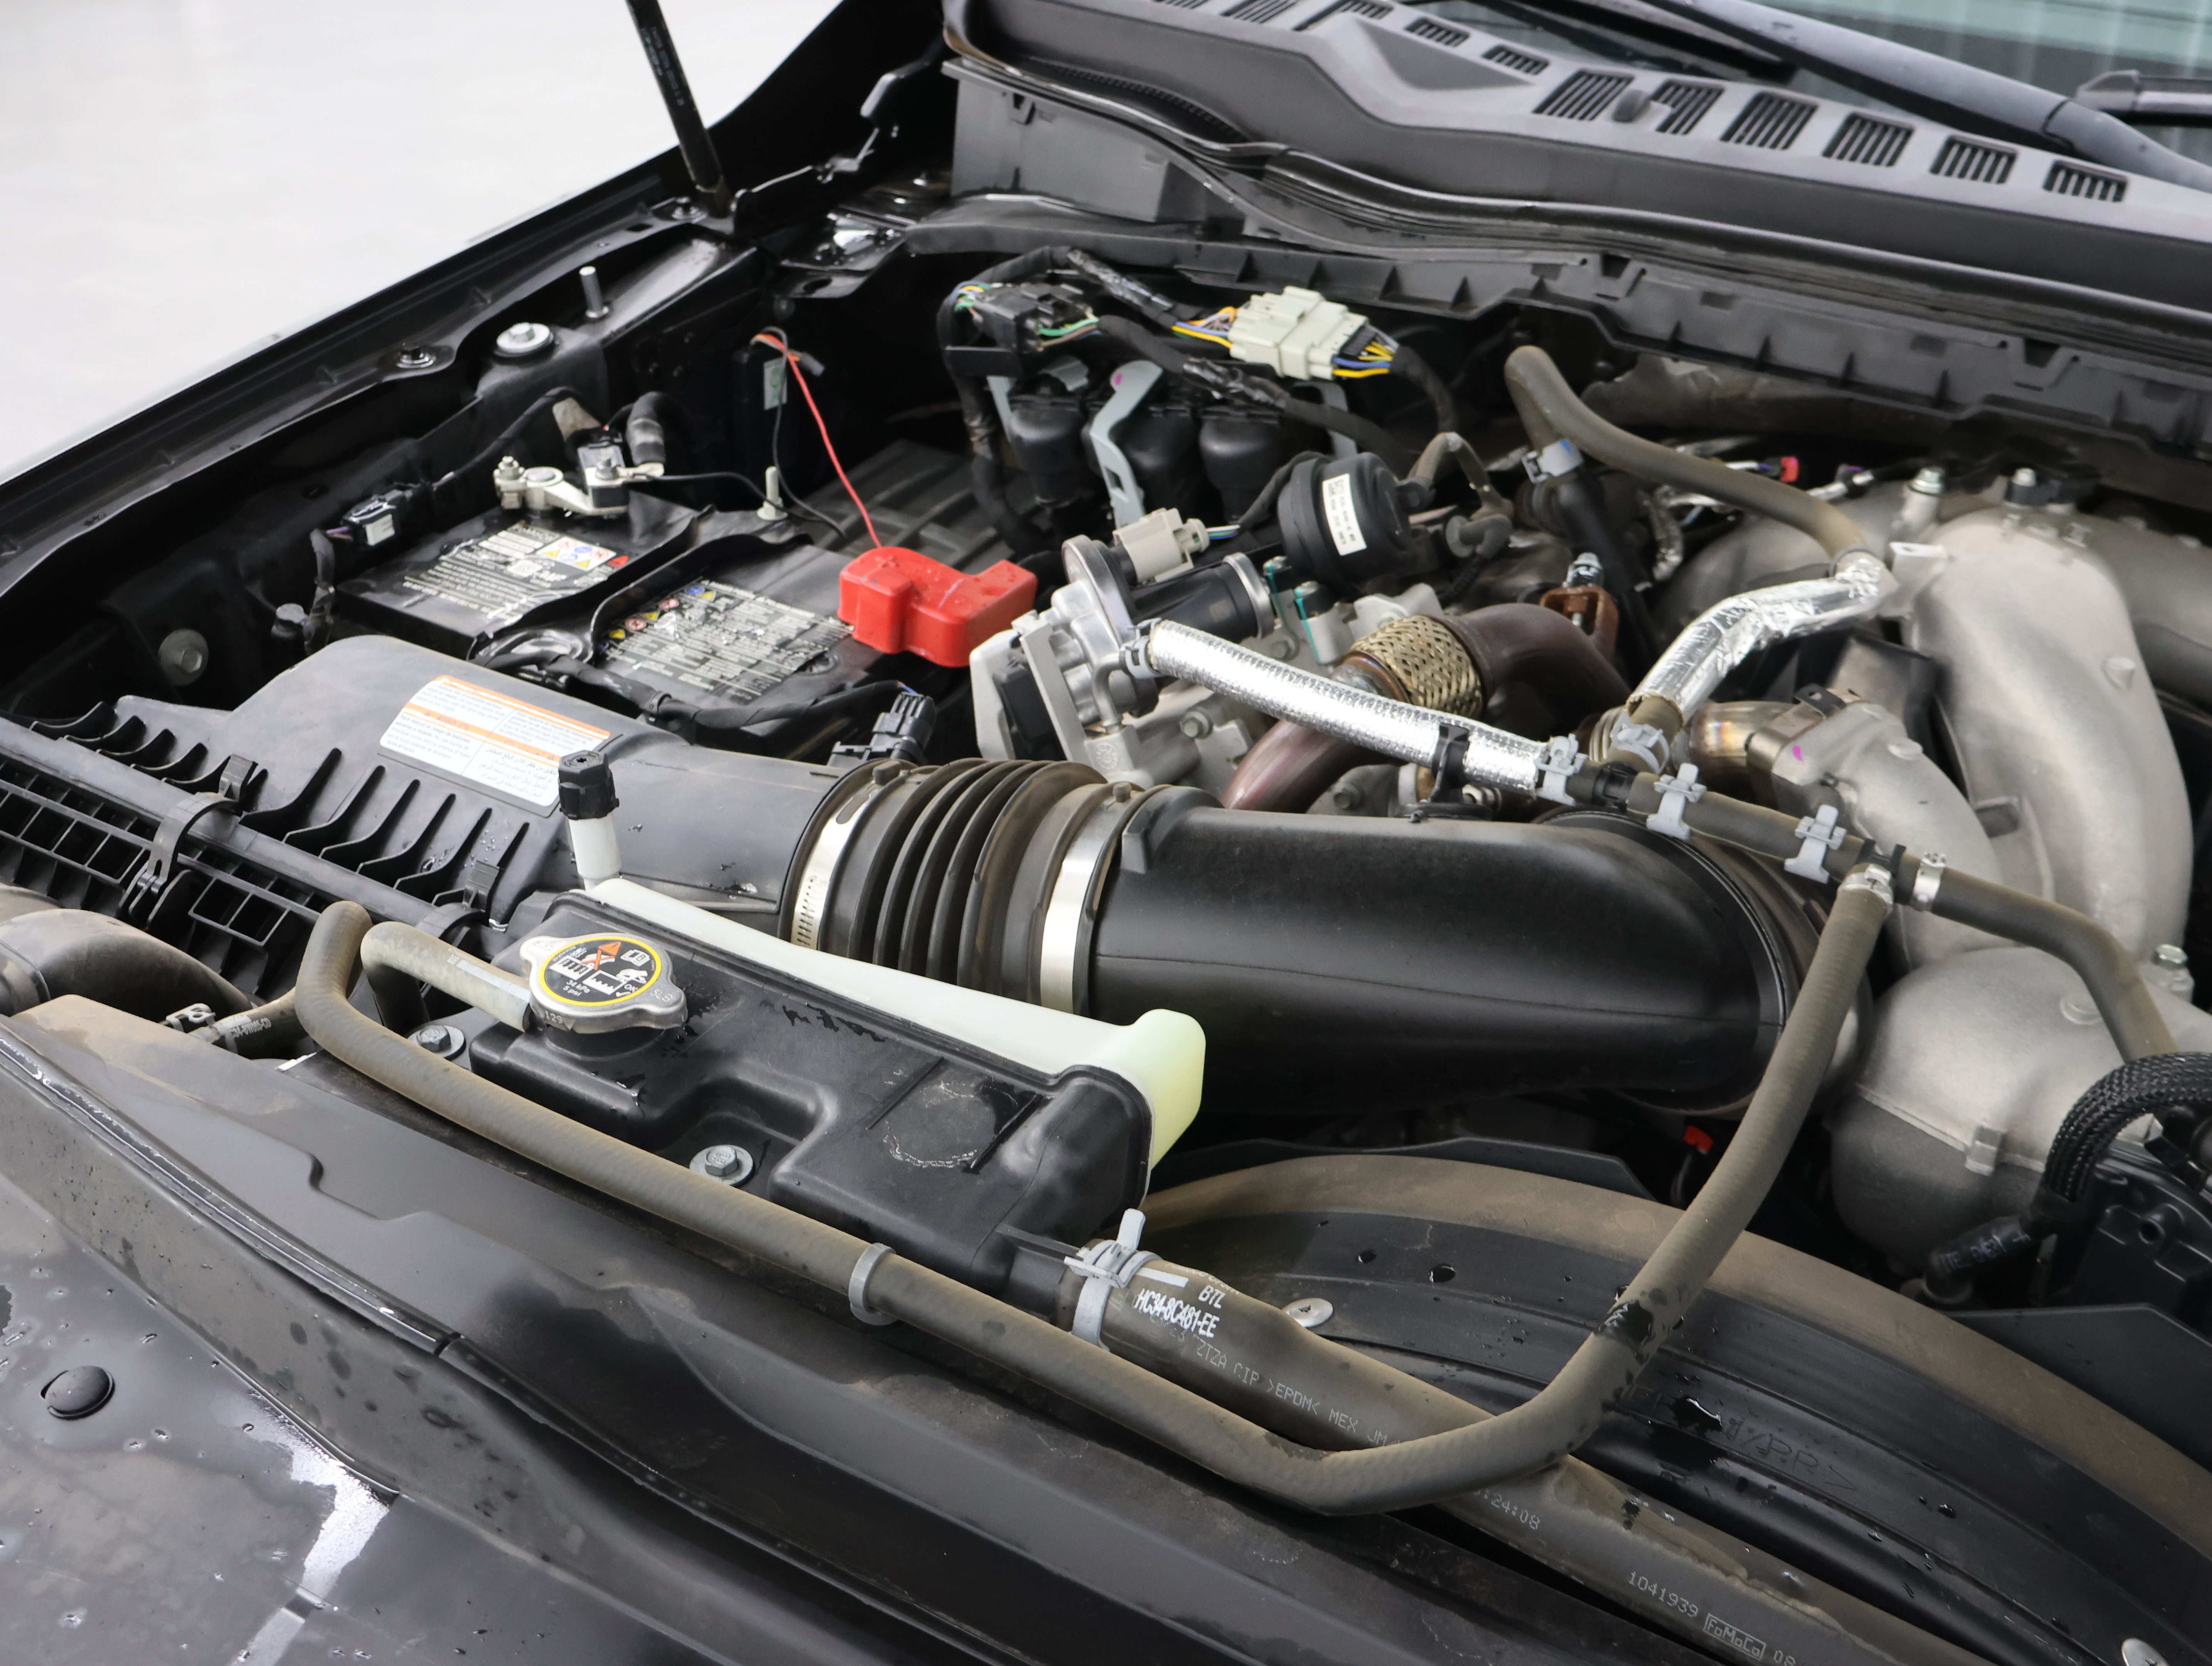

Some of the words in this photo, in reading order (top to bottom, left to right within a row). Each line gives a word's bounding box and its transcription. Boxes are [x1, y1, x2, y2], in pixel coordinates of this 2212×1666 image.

[567, 988, 582, 997] psi
[575, 983, 591, 993] kPa
[624, 983, 638, 992] OK
[1198, 1284, 1226, 1309] BTL
[1329, 1408, 1358, 1433] MEX
[1628, 1570, 1699, 1617] 1041939
[1706, 1616, 1762, 1657] FoMoCo
